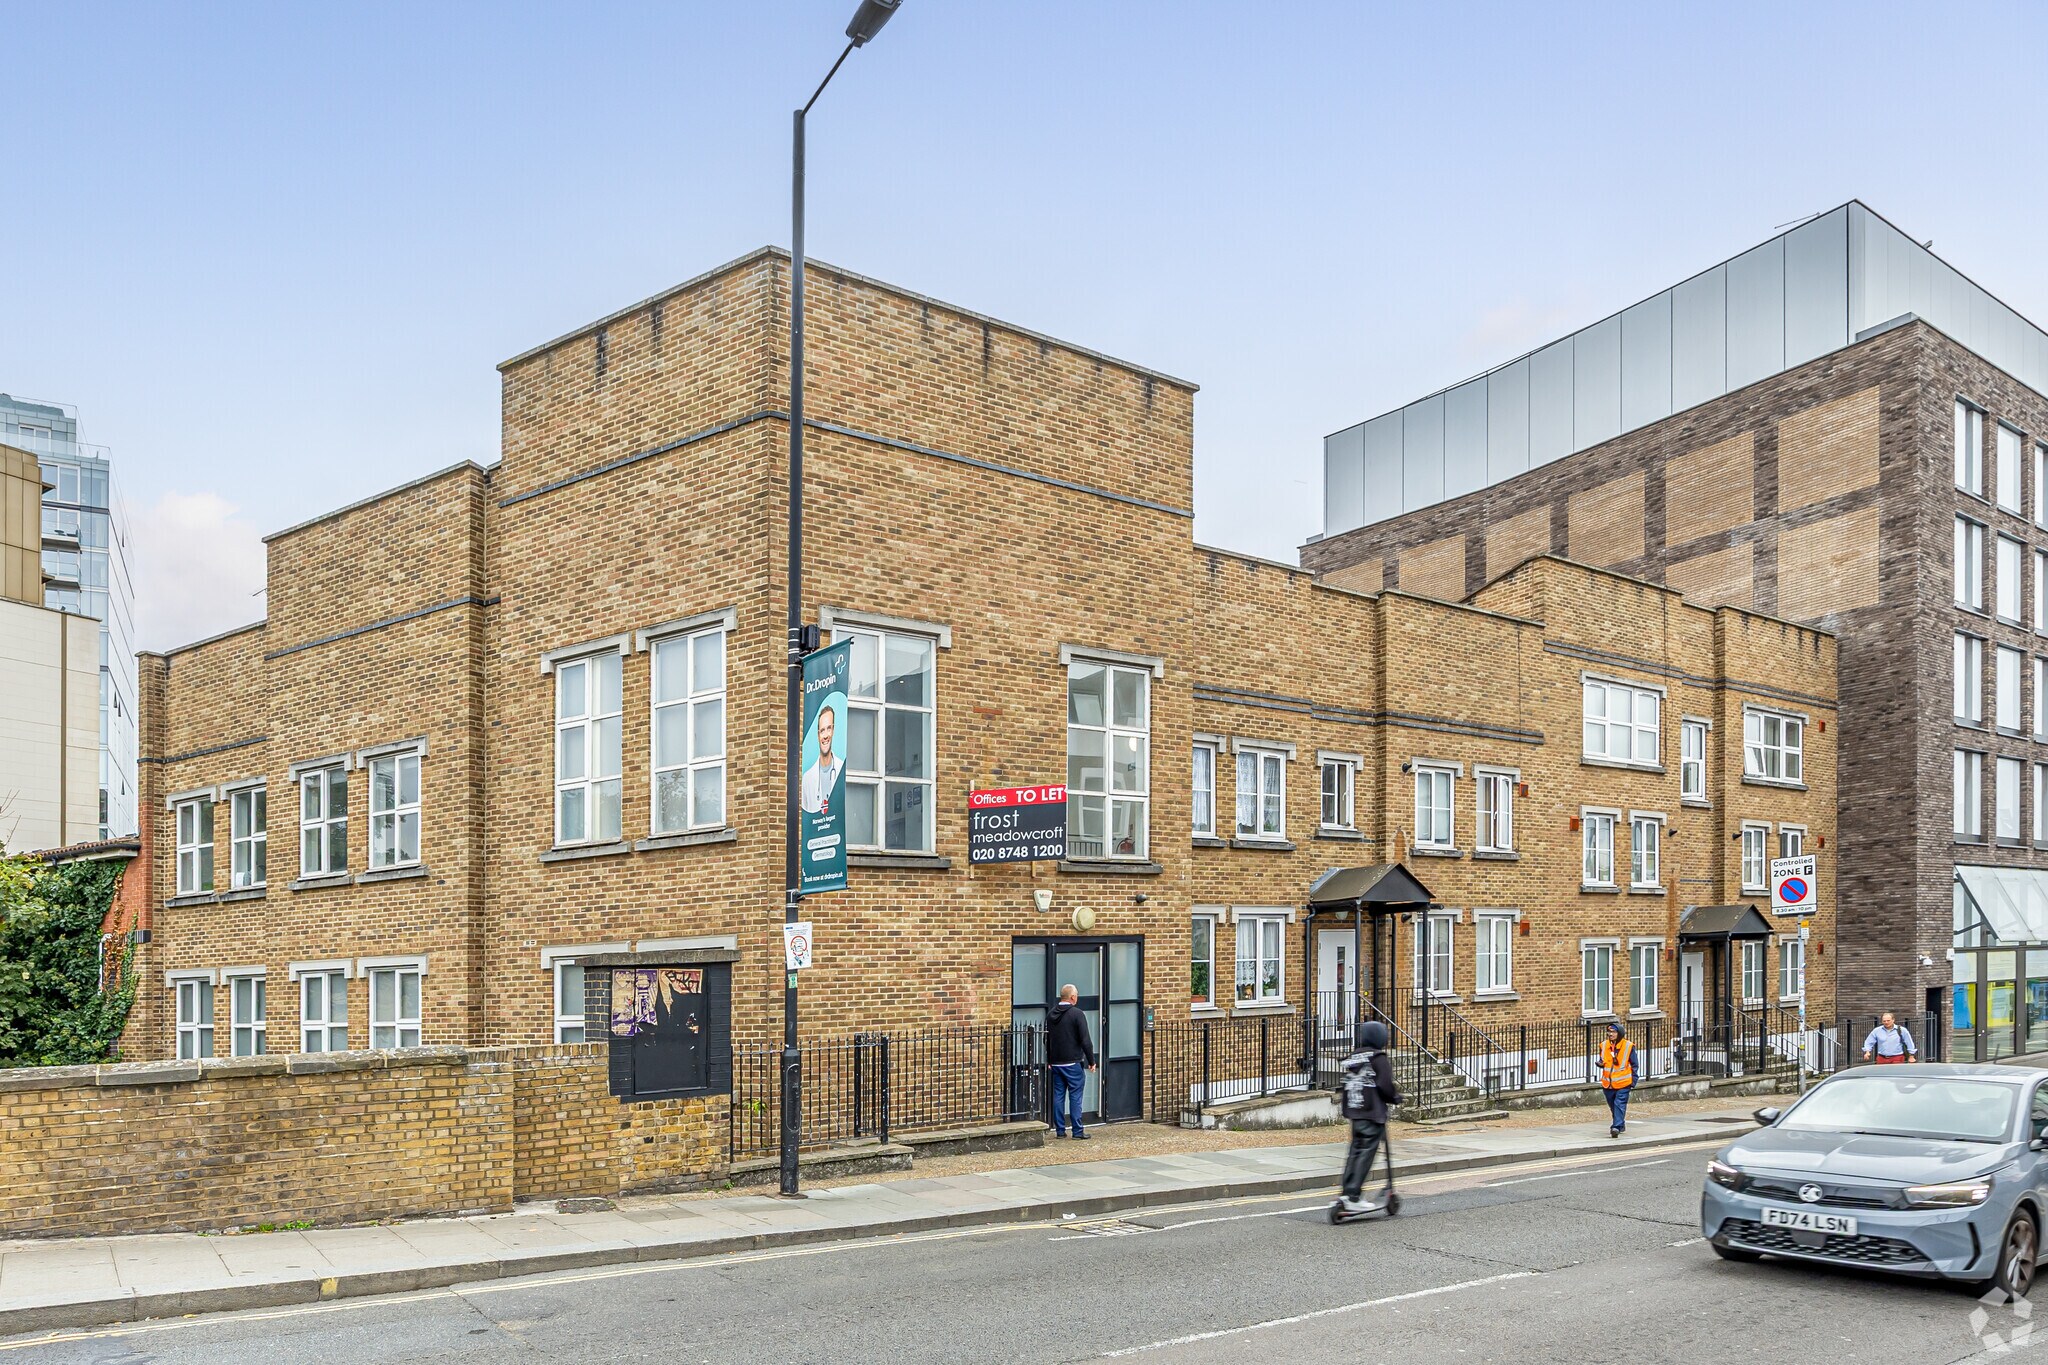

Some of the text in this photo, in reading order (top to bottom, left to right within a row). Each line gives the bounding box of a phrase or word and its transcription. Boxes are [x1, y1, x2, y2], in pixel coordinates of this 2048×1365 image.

[806, 673, 836, 693] Dr.Dropin
[973, 788, 1064, 805] Offices TO LET
[974, 810, 1020, 830] frost
[973, 826, 1064, 844] meadowcroft
[972, 844, 1063, 860] 020 8748 1200
[1774, 858, 1812, 867] Controlled
[1774, 868, 1801, 877] ZONE
[1769, 1210, 1848, 1232] FD74 LSN
